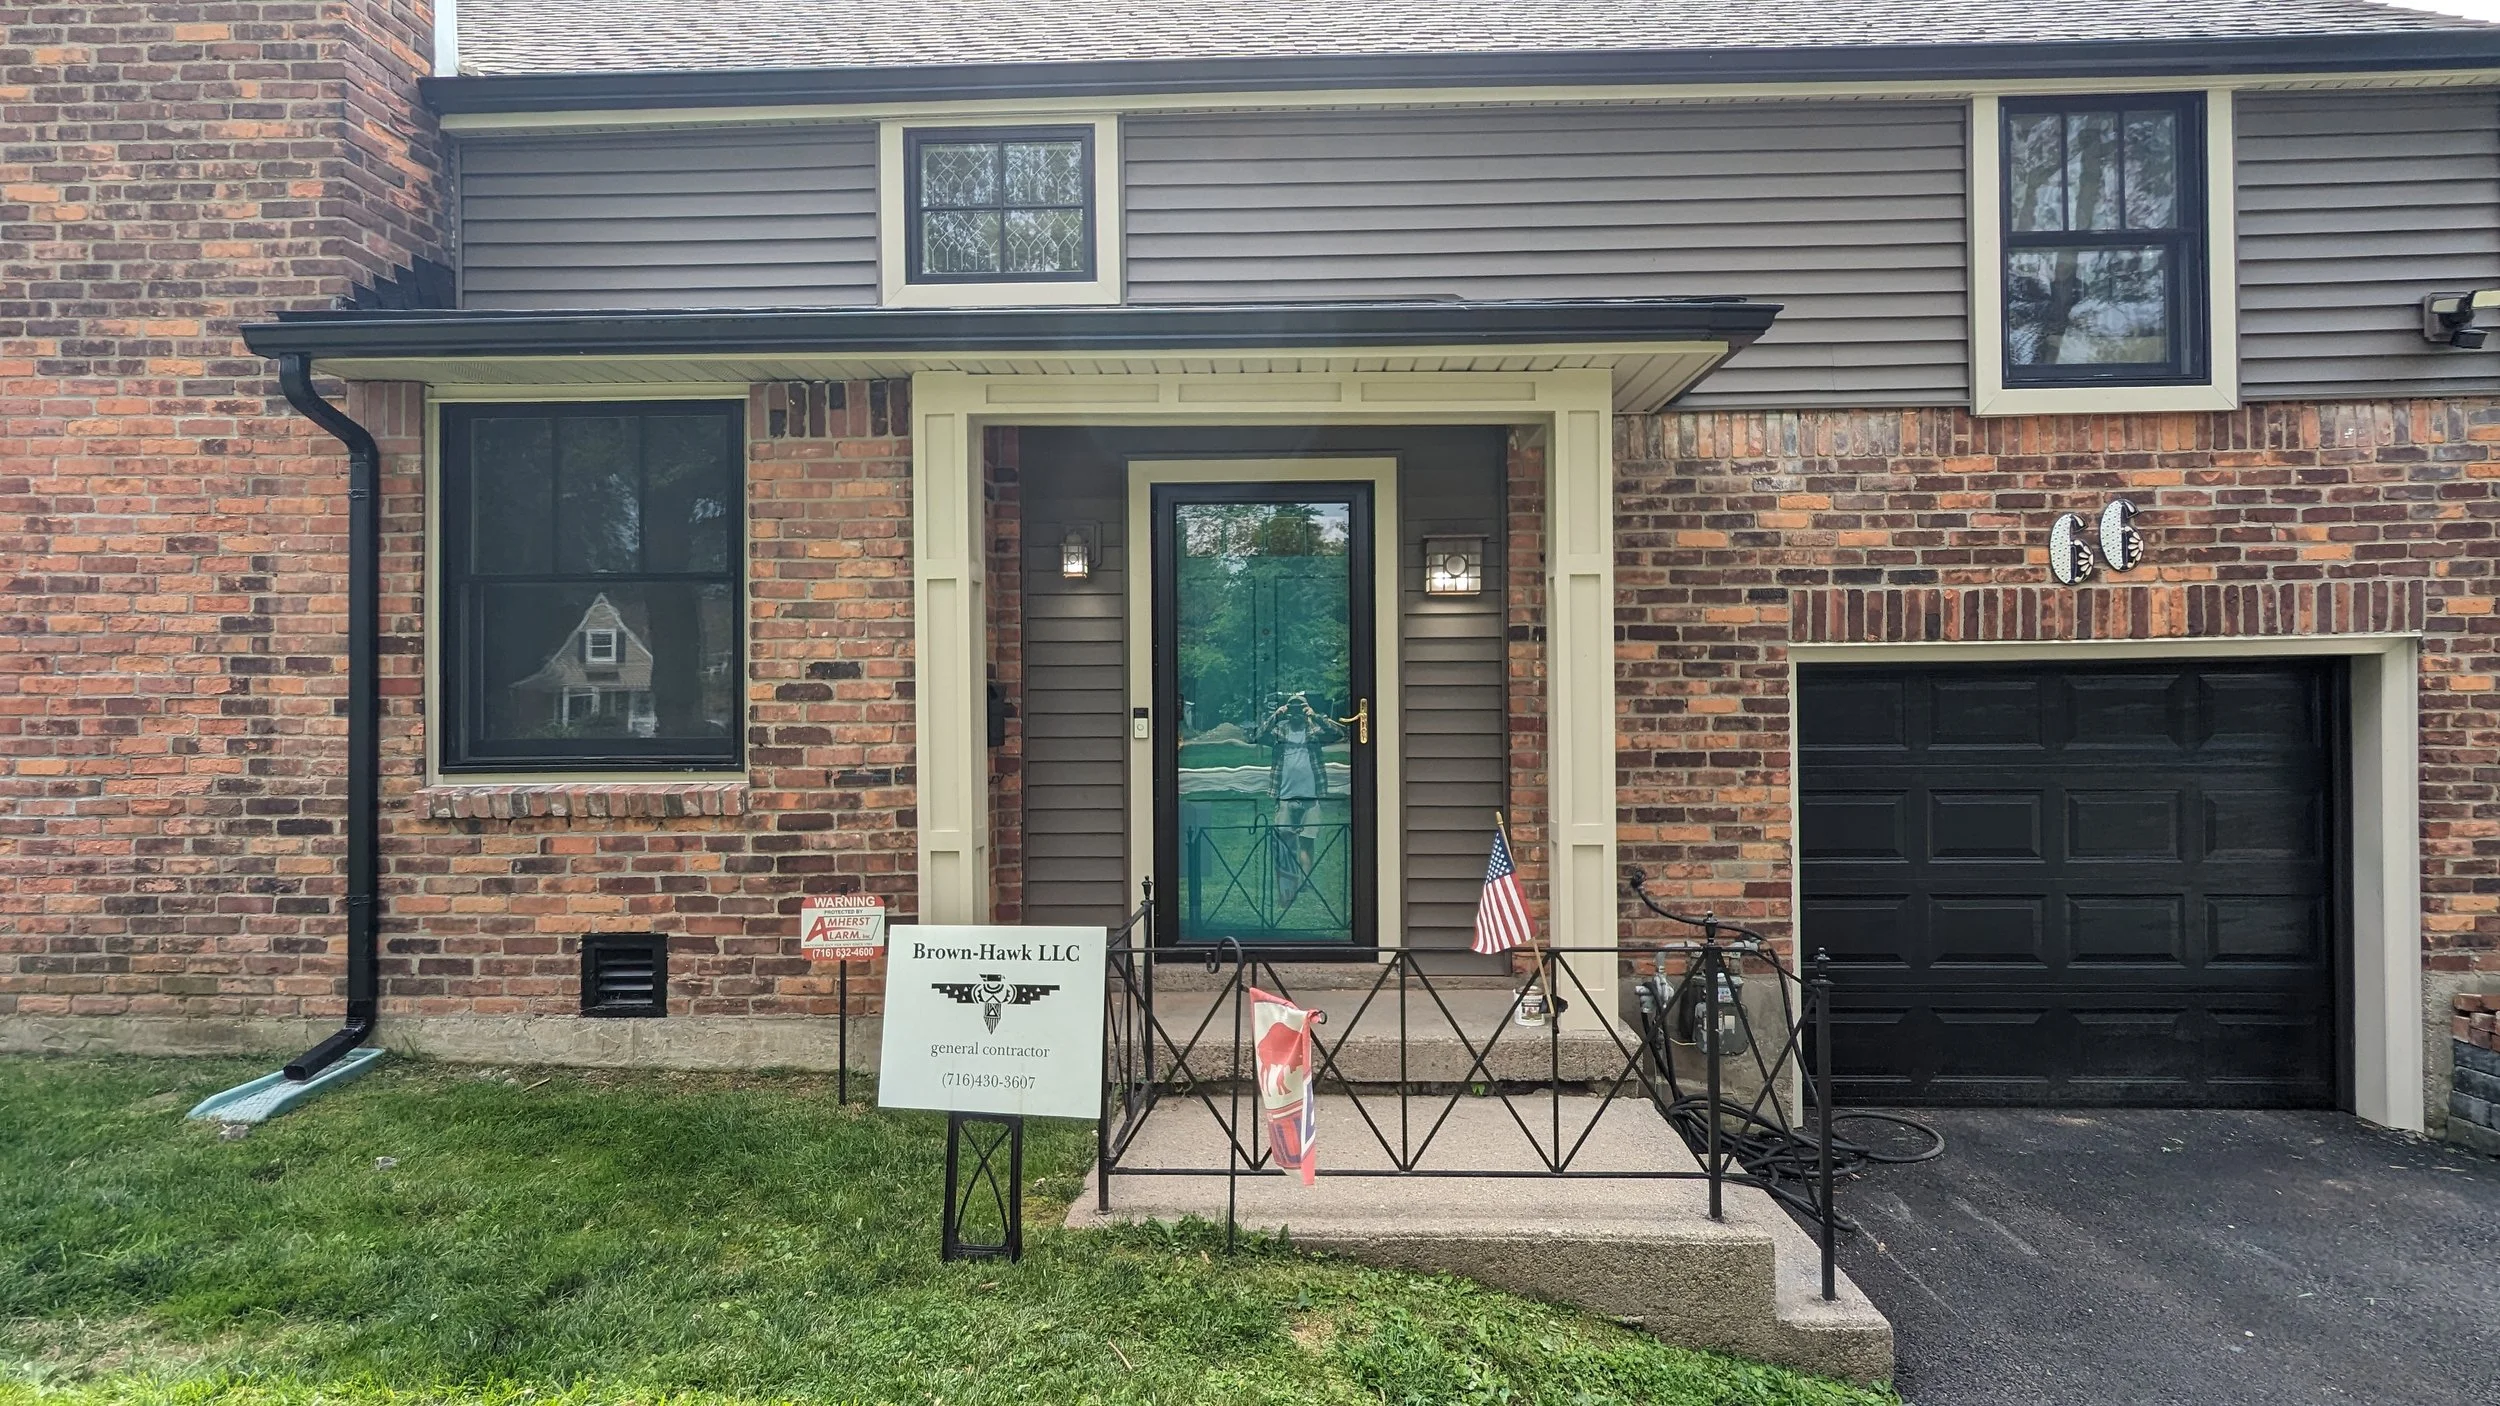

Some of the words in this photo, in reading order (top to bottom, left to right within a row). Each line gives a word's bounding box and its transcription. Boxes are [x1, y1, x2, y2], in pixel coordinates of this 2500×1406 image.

[2050, 499, 2144, 586] 66
[814, 896, 875, 908] WARNING
[812, 948, 834, 959] (716)
[836, 948, 874, 957] 632-4600
[912, 943, 1032, 961] Brown-Hawk
[1038, 944, 1080, 962] LLC
[930, 1042, 979, 1057] general
[982, 1045, 1050, 1058] contractor
[942, 1072, 1036, 1089] (716)430-3607
